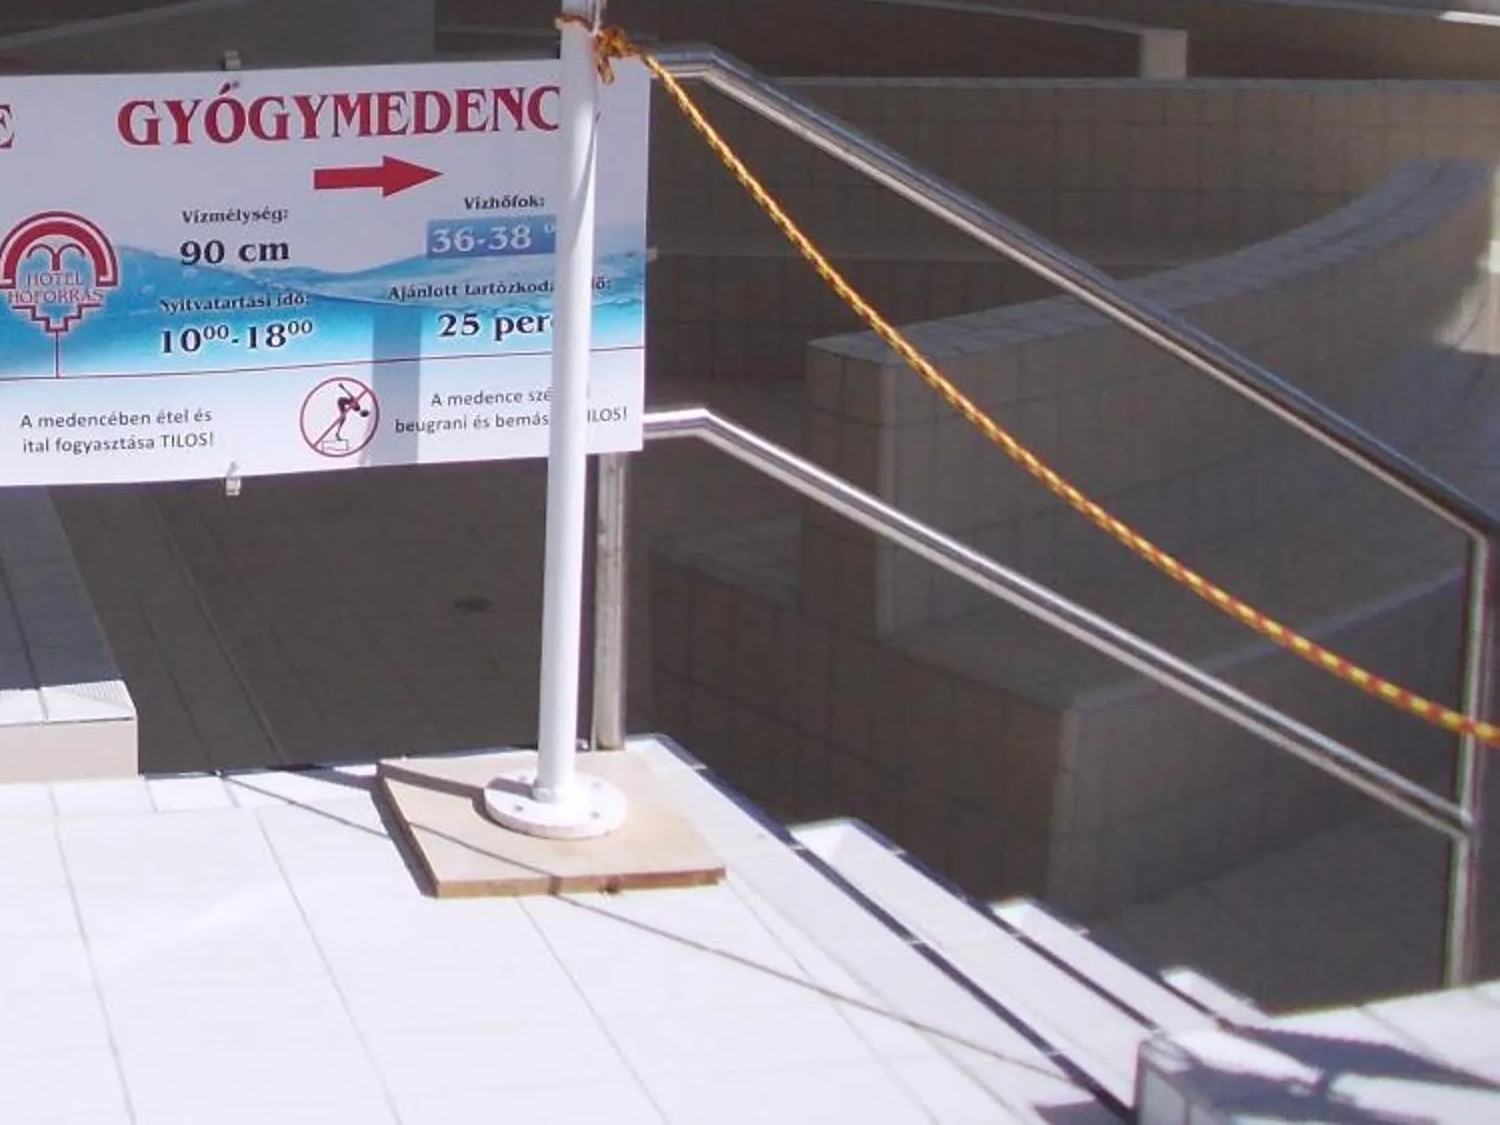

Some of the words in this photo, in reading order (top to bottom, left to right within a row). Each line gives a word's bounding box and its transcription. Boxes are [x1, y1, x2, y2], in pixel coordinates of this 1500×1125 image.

[117, 81, 561, 147] GYÓGYMEDENC
[431, 224, 533, 254] 36-38
[180, 239, 225, 266] 90
[238, 242, 289, 263] cm
[27, 271, 84, 287] HOTEL
[159, 293, 271, 316] Nyitvatartási
[277, 291, 310, 307] idő:
[388, 282, 458, 302] Ajánlott
[438, 312, 480, 338] 25
[493, 313, 553, 342] per
[431, 391, 443, 407] A
[446, 389, 523, 407] medence
[20, 413, 33, 429] A
[37, 410, 151, 429] medencében
[156, 408, 189, 425] étel
[194, 407, 212, 423] és
[395, 417, 467, 435] beugrani
[473, 412, 490, 430] és
[587, 406, 627, 423] ILOS!
[23, 436, 49, 454] ital
[55, 435, 156, 455] fogyasztása
[160, 431, 214, 449] TILOS!
